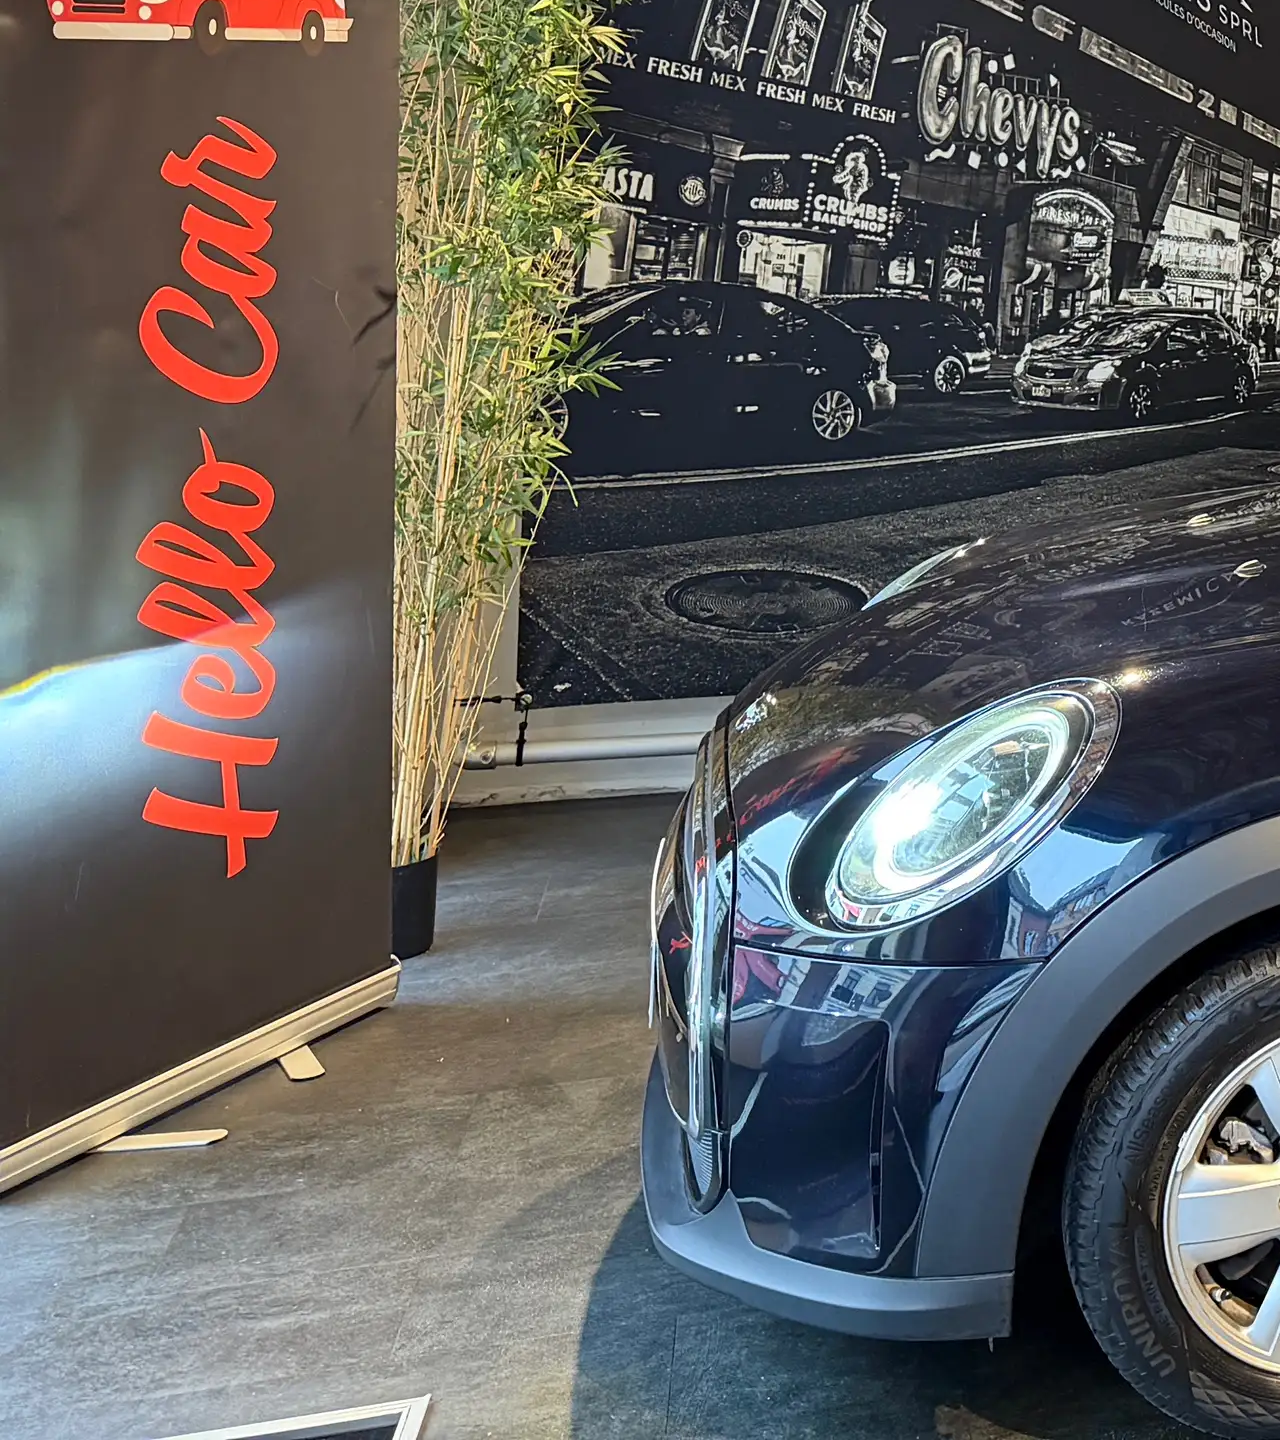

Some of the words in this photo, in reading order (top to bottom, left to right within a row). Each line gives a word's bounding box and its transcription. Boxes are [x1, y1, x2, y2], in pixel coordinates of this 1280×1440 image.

[1186, 11, 1237, 53] D'OCCASION
[1218, 4, 1263, 48] SPRL
[647, 57, 703, 83] FRESH
[710, 72, 746, 91] MEX
[756, 81, 806, 105] FRESH
[812, 93, 844, 113] MEX
[853, 102, 896, 124] FRESH
[918, 35, 1081, 179] Chevys
[602, 166, 654, 202] ASTA
[750, 196, 800, 211] CRUMBS
[813, 192, 889, 223] CRUMBS
[852, 218, 887, 233] SHOP
[139, 115, 280, 405] Car
[135, 427, 280, 878] Hello
